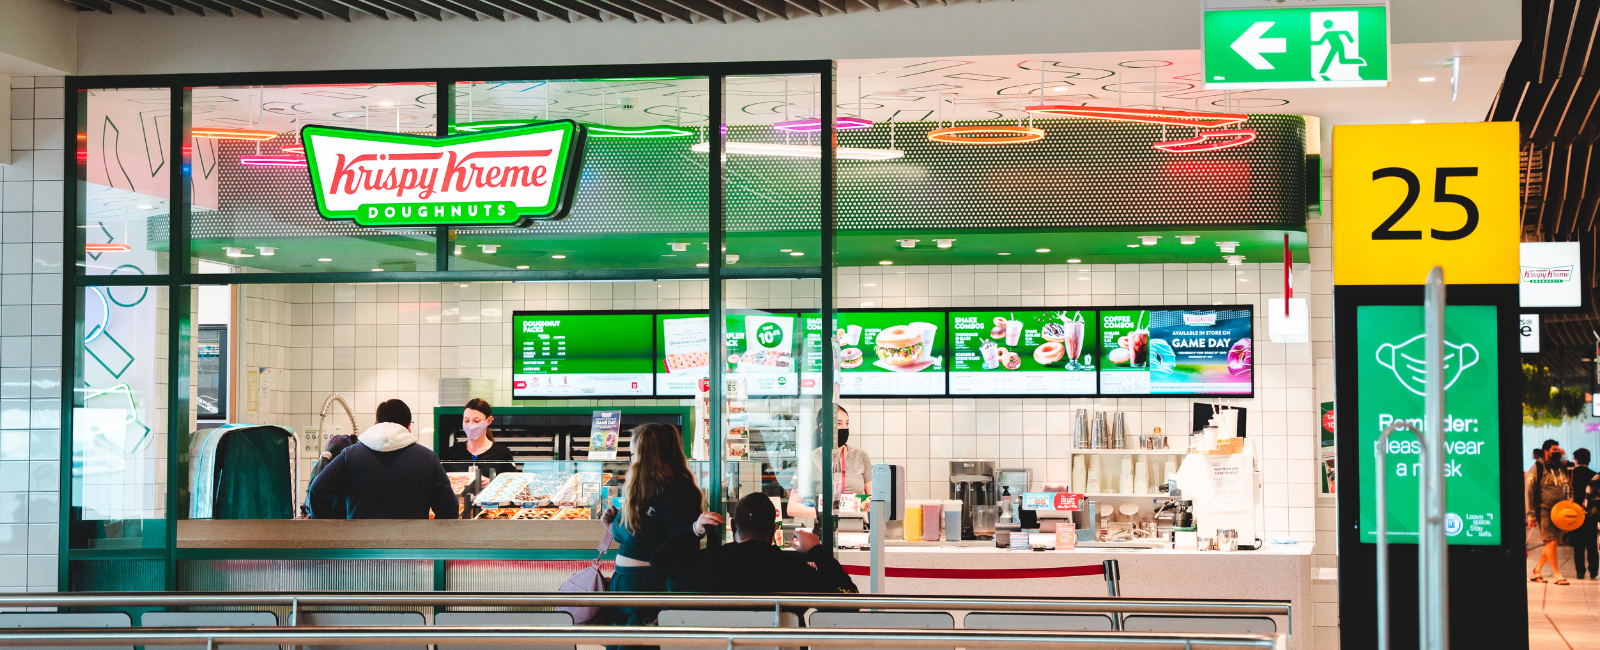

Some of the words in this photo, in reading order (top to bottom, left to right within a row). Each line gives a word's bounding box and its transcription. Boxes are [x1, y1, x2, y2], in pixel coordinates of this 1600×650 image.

[330, 152, 443, 200] Krispy
[441, 148, 552, 192] Kreme
[368, 204, 506, 219] DOUGHNUTS
[1372, 167, 1479, 240] 25
[1172, 338, 1205, 348] GAME
[1208, 338, 1231, 347] DAY
[1379, 414, 1478, 432] Remider:
[1396, 463, 1407, 476] a
